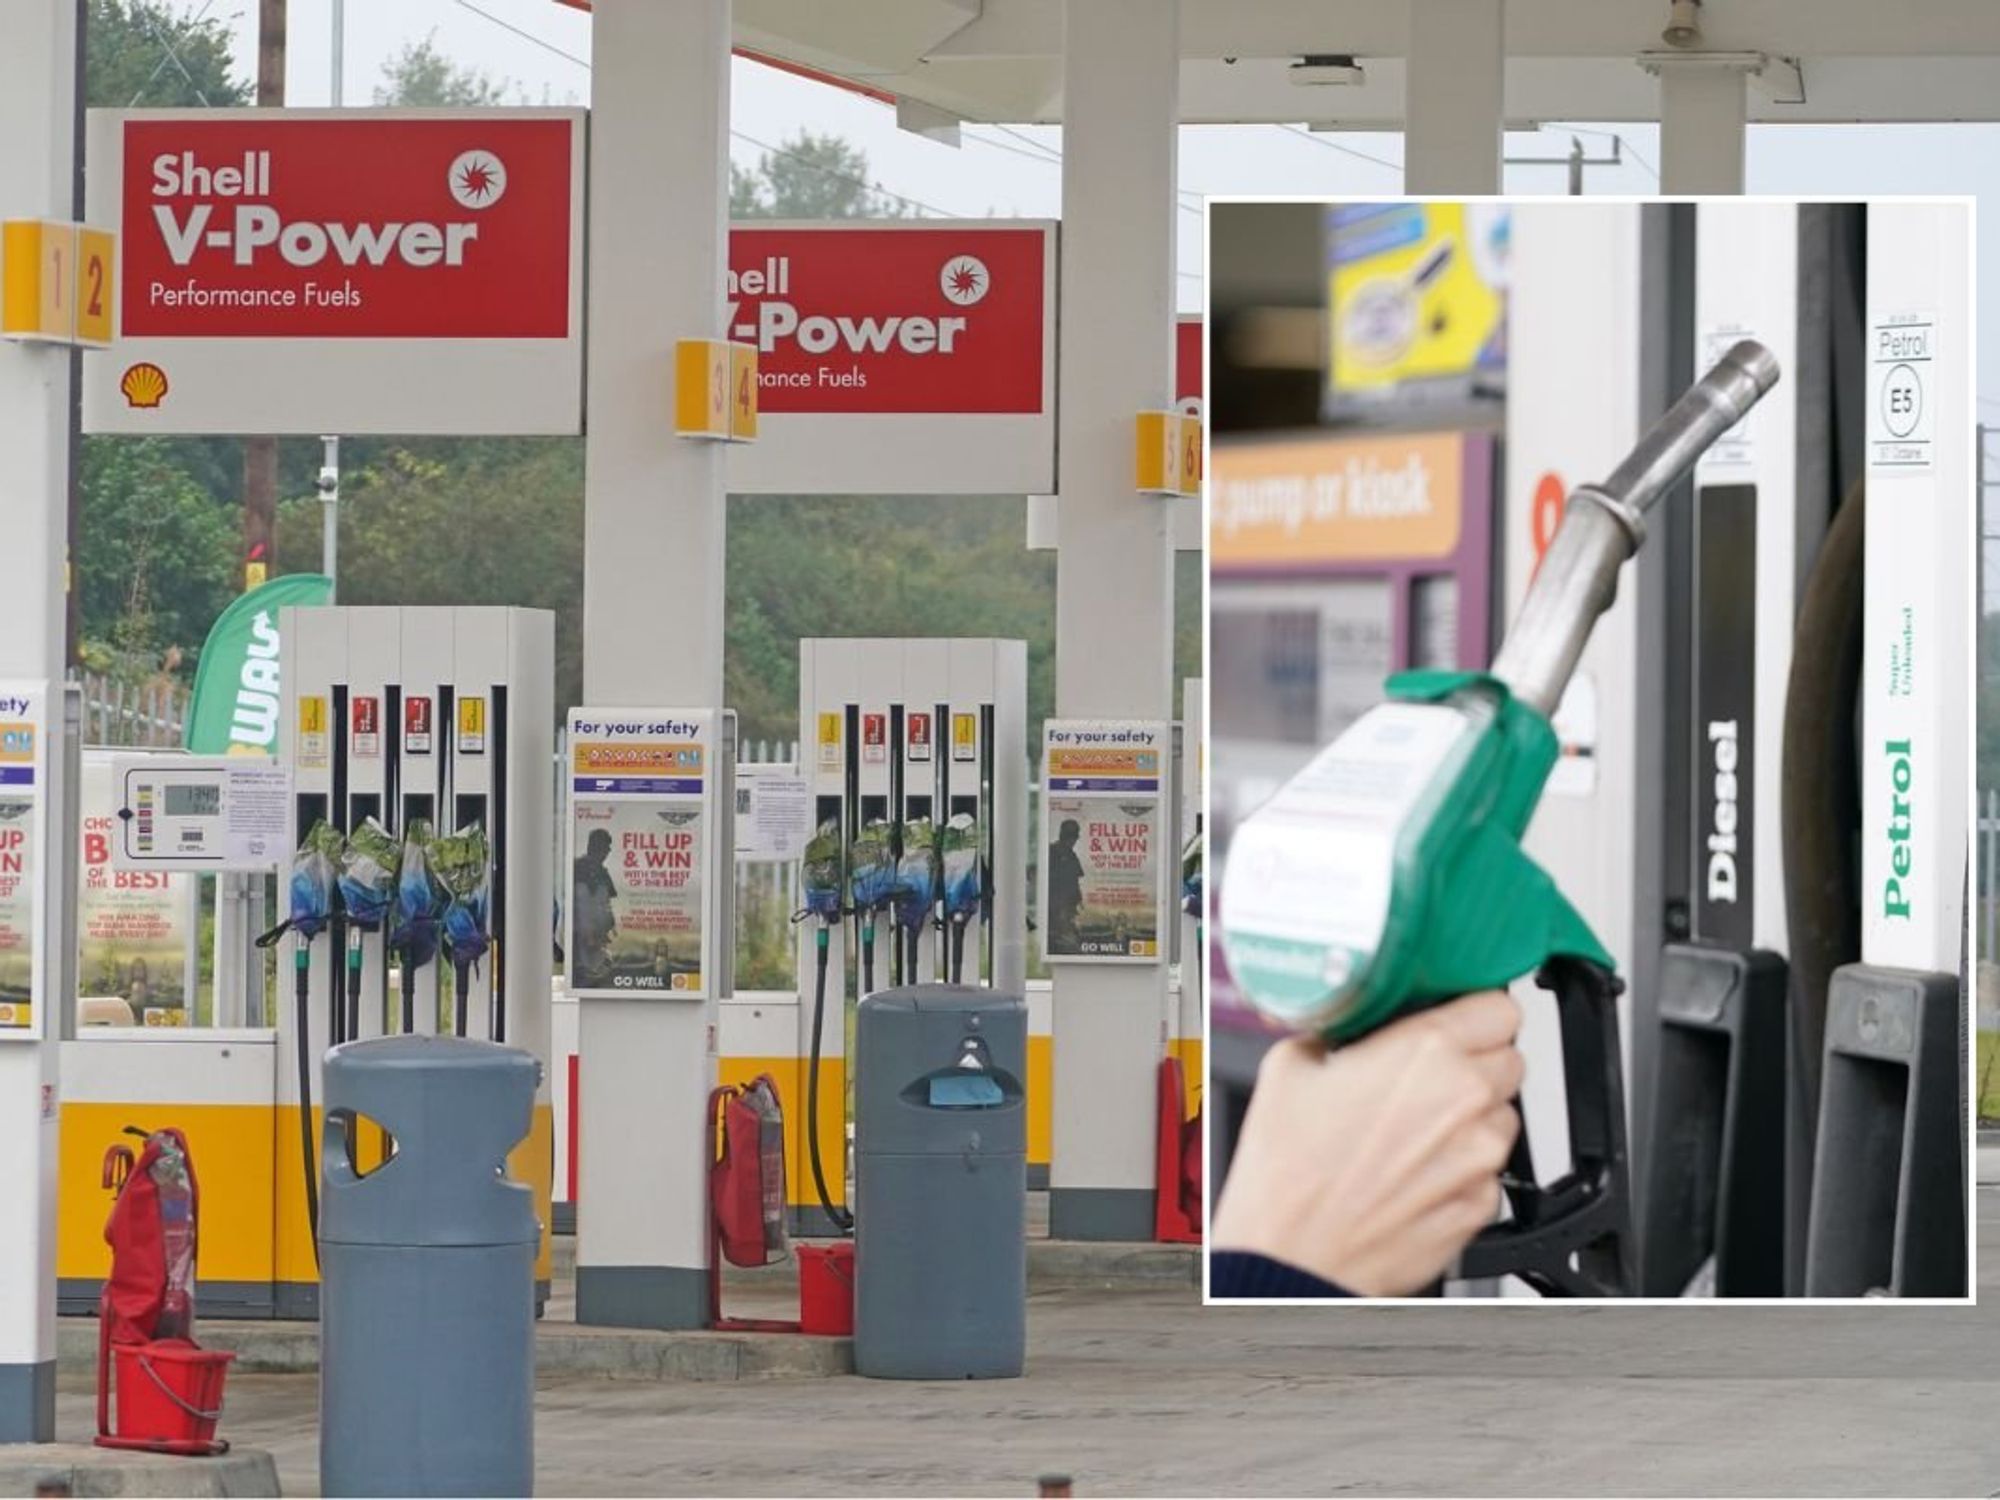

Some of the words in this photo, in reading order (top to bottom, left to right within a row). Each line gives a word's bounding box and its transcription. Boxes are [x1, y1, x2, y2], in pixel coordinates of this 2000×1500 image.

[152, 150, 270, 196] Shell
[152, 204, 478, 266] V-Power
[87, 254, 103, 317] 2
[728, 257, 789, 295] ell
[150, 282, 296, 308] Performance
[304, 280, 361, 307] Fuels
[728, 301, 966, 353] -Power
[1880, 331, 1928, 356] Petrol
[713, 360, 725, 414] 3
[818, 365, 867, 388] Fuels
[738, 366, 750, 416] 4
[1891, 388, 1913, 413] E5
[1185, 434, 1195, 478] 6
[0, 698, 30, 716] ety
[575, 720, 600, 734] For
[605, 723, 642, 738] your
[647, 720, 700, 739] safety
[1049, 729, 1071, 742] For
[1074, 733, 1107, 745] your
[1111, 730, 1155, 745] safety
[1708, 720, 1738, 903] Diesel
[622, 832, 659, 850] FILL
[665, 832, 693, 850] UP
[1089, 822, 1120, 837] FILL
[1125, 823, 1149, 837] UP
[1885, 738, 1911, 919] Petrol
[1090, 838, 1103, 852] &
[1108, 838, 1147, 852] WIN
[624, 850, 640, 868] &
[645, 851, 691, 868] WIN
[114, 869, 168, 889] BEST
[1081, 942, 1098, 953] GO
[614, 976, 633, 987] GO
[635, 976, 665, 987] WELL
